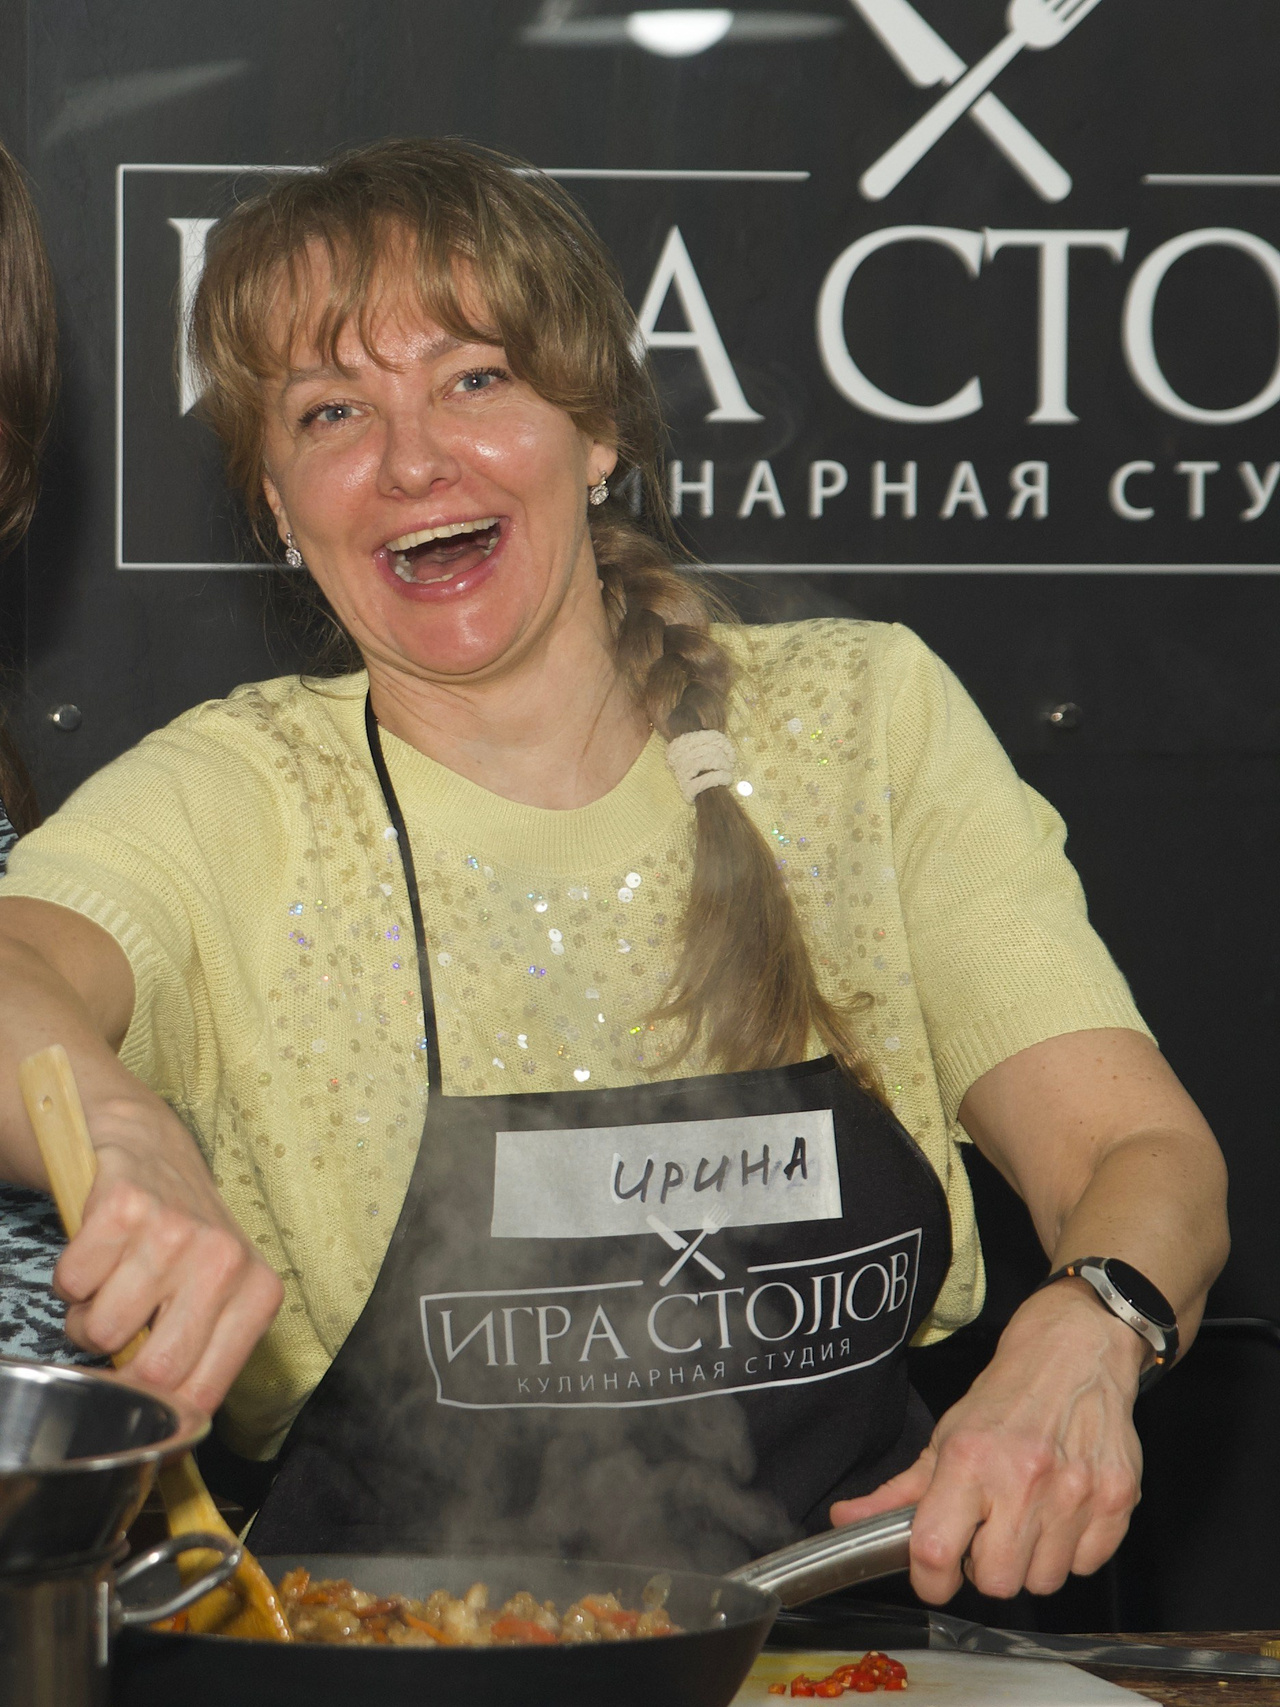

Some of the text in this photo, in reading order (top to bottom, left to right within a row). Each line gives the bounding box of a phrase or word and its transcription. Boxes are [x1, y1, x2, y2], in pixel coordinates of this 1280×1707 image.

[617, 459, 1050, 519] НАРНАЯ
[612, 1136, 809, 1205] ИРИНА
[440, 1251, 910, 1368] ИГРА СТОЛОВ
[517, 1337, 851, 1394] КУЛИНАРНАЯ СТУДИЯ
